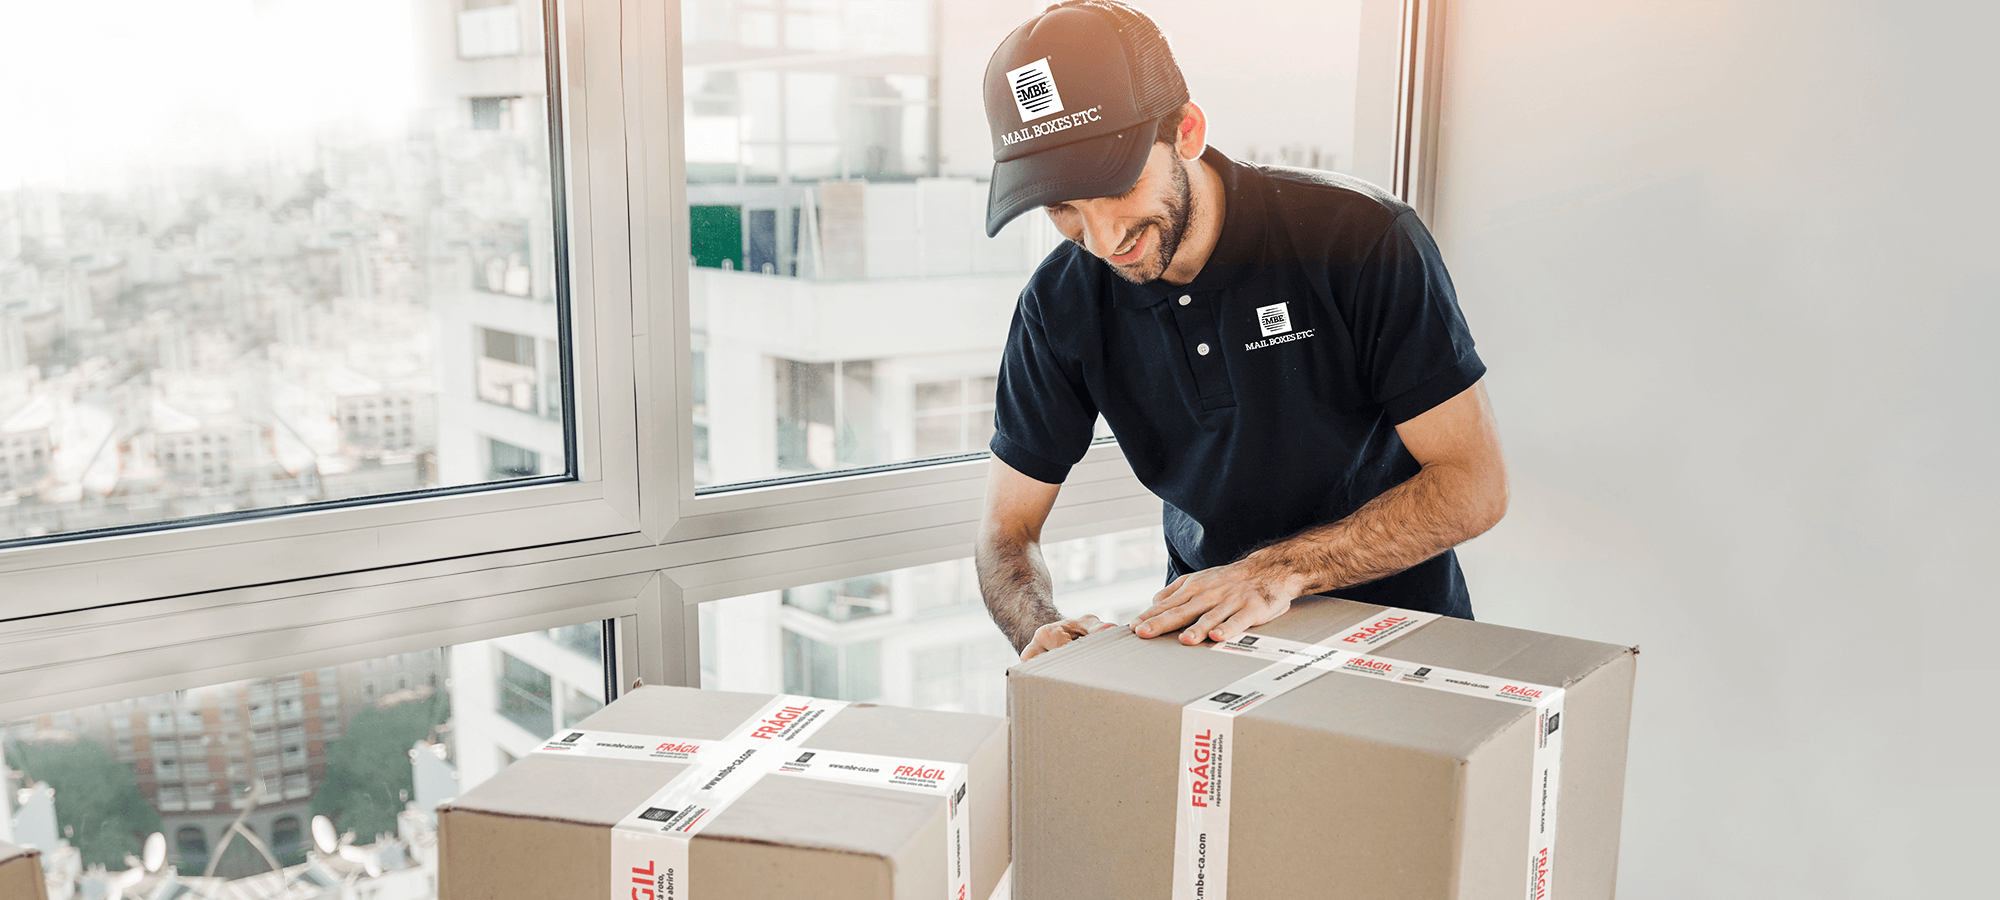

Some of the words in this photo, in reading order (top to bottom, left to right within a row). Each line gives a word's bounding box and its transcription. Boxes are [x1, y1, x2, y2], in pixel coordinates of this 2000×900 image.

[1020, 81, 1049, 101] MBE
[1001, 128, 1034, 146] MAIL
[1033, 115, 1072, 138] BOXES
[1264, 315, 1285, 325] MBE
[1245, 339, 1269, 351] MAIL
[1269, 334, 1296, 346] BOXES
[1342, 616, 1408, 643] FRÁGIL
[1346, 658, 1392, 672] FRÁGIL
[1500, 684, 1543, 698] FRÁGIL
[750, 705, 809, 739] FRÁGIL
[655, 742, 700, 753] FRÁGIL
[893, 765, 945, 780] FRÁGIL
[1188, 729, 1211, 807] FRÁGIL
[1195, 833, 1206, 900] .mbe-ca.com
[657, 874, 665, 892] roto,
[666, 868, 674, 895] abrirlo
